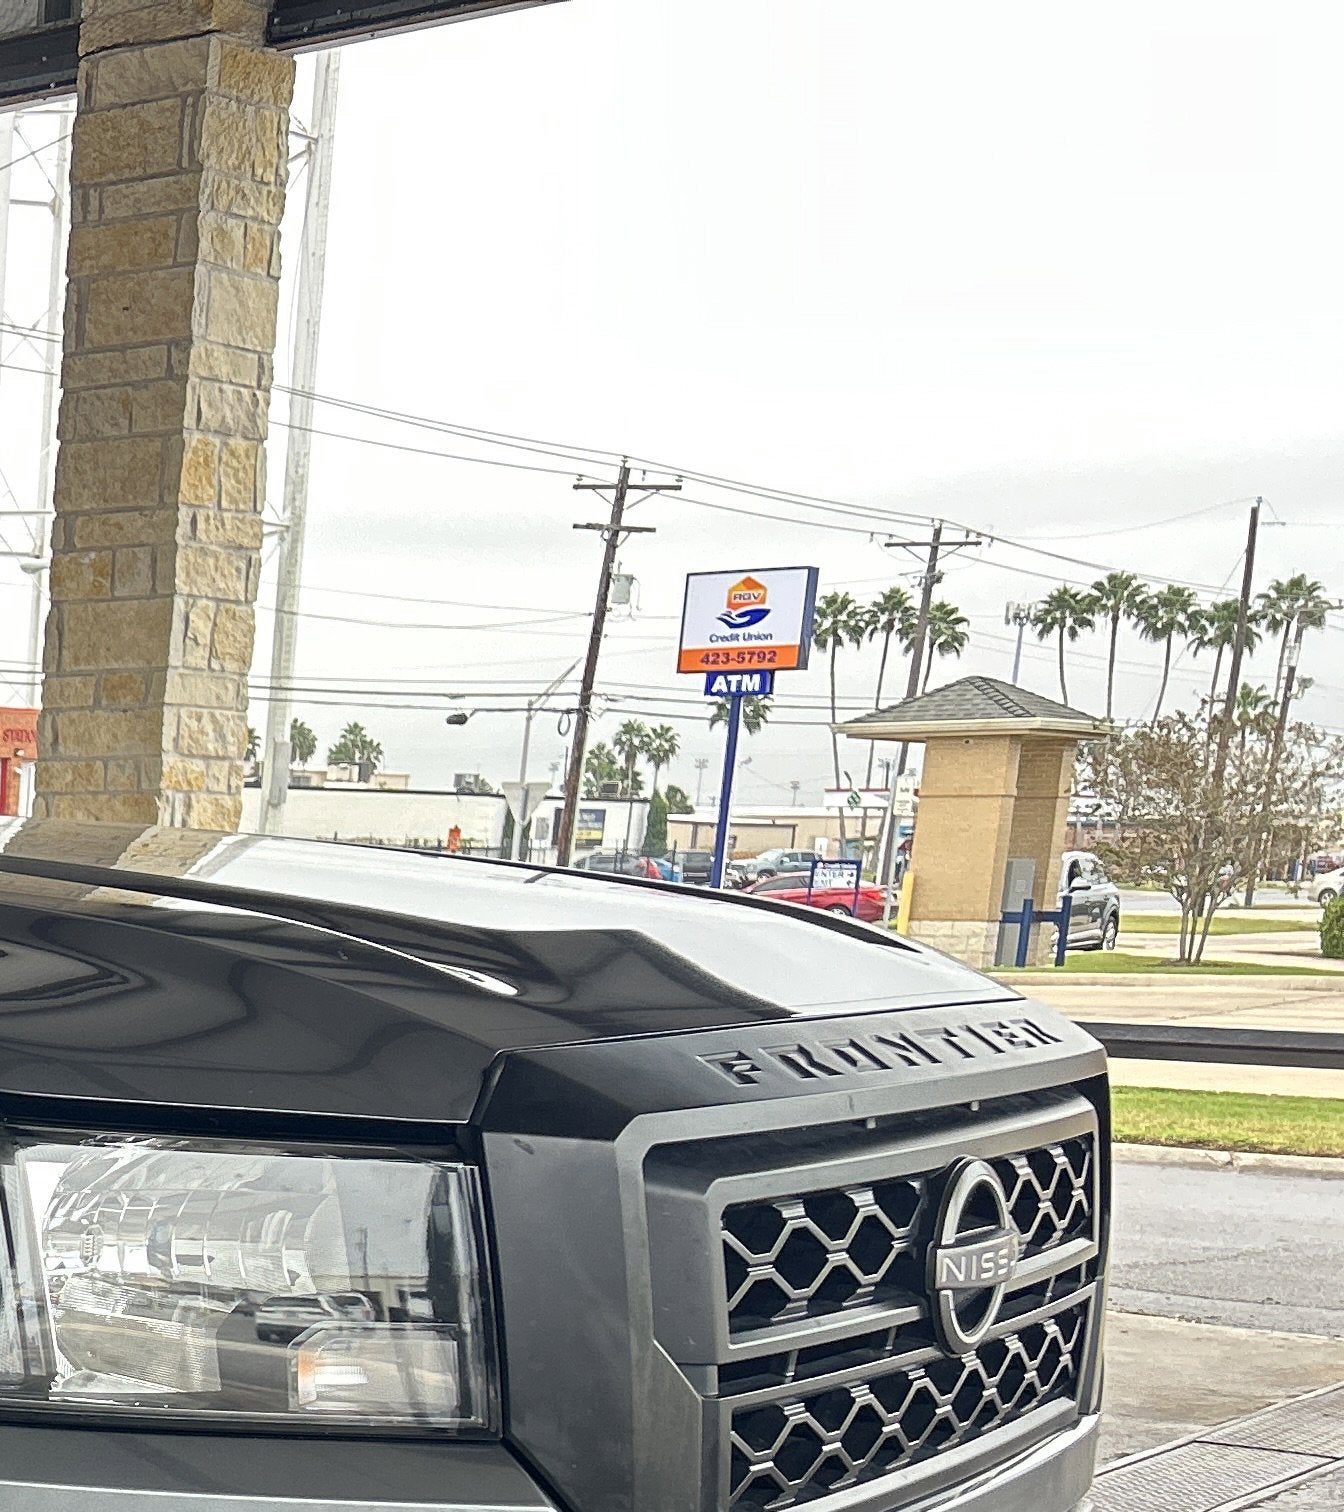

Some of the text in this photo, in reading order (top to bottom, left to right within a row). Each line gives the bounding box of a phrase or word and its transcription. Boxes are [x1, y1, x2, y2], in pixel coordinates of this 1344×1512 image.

[709, 631, 773, 643] Credit Union
[700, 650, 777, 665] 423-5792
[711, 674, 761, 693] ATM
[695, 1017, 1064, 1087] FRONTIER
[941, 1248, 1016, 1283] NISS
